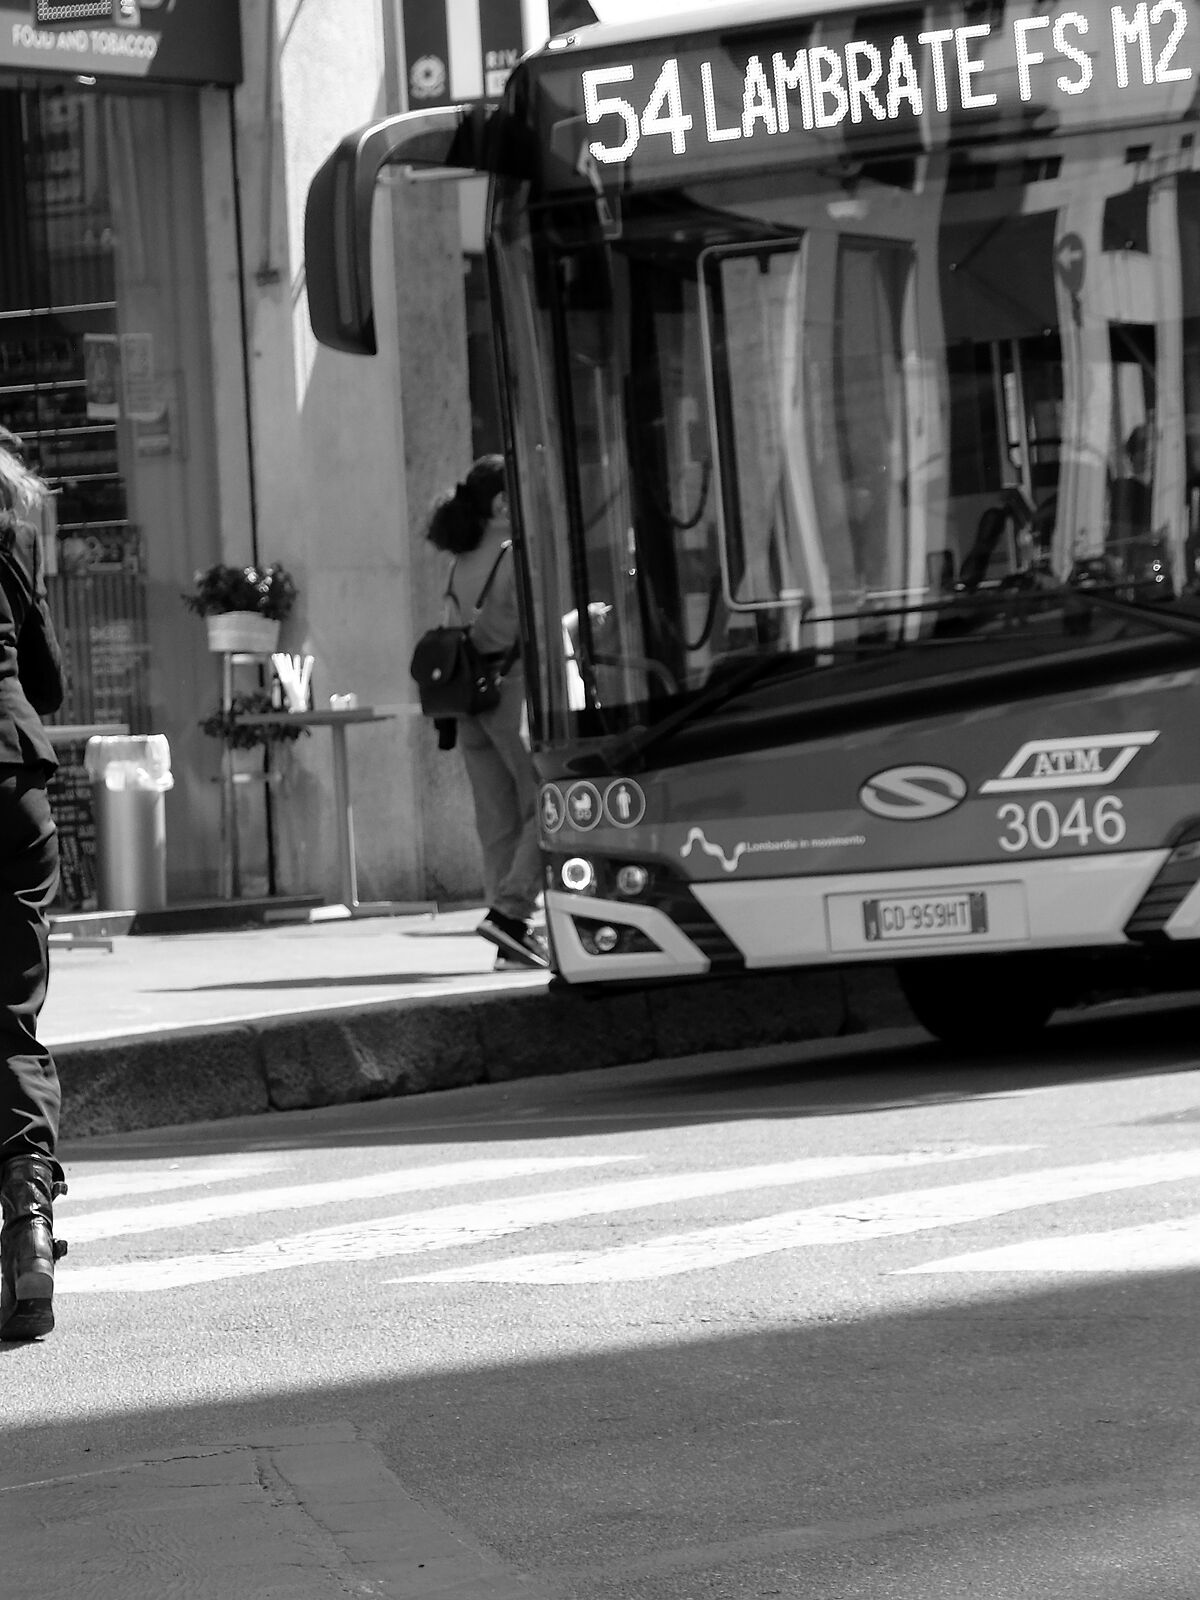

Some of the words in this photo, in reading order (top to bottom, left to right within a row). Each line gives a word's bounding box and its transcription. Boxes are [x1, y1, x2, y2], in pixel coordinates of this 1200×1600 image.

[56, 30, 89, 52] AND
[90, 31, 158, 59] TOBACCO
[582, 58, 692, 164] 54
[701, 23, 998, 143] LAMBRATE
[1013, 12, 1094, 101] FS
[1111, 0, 1193, 88] M2
[1032, 748, 1104, 776] ATM
[997, 795, 1127, 852] 3046
